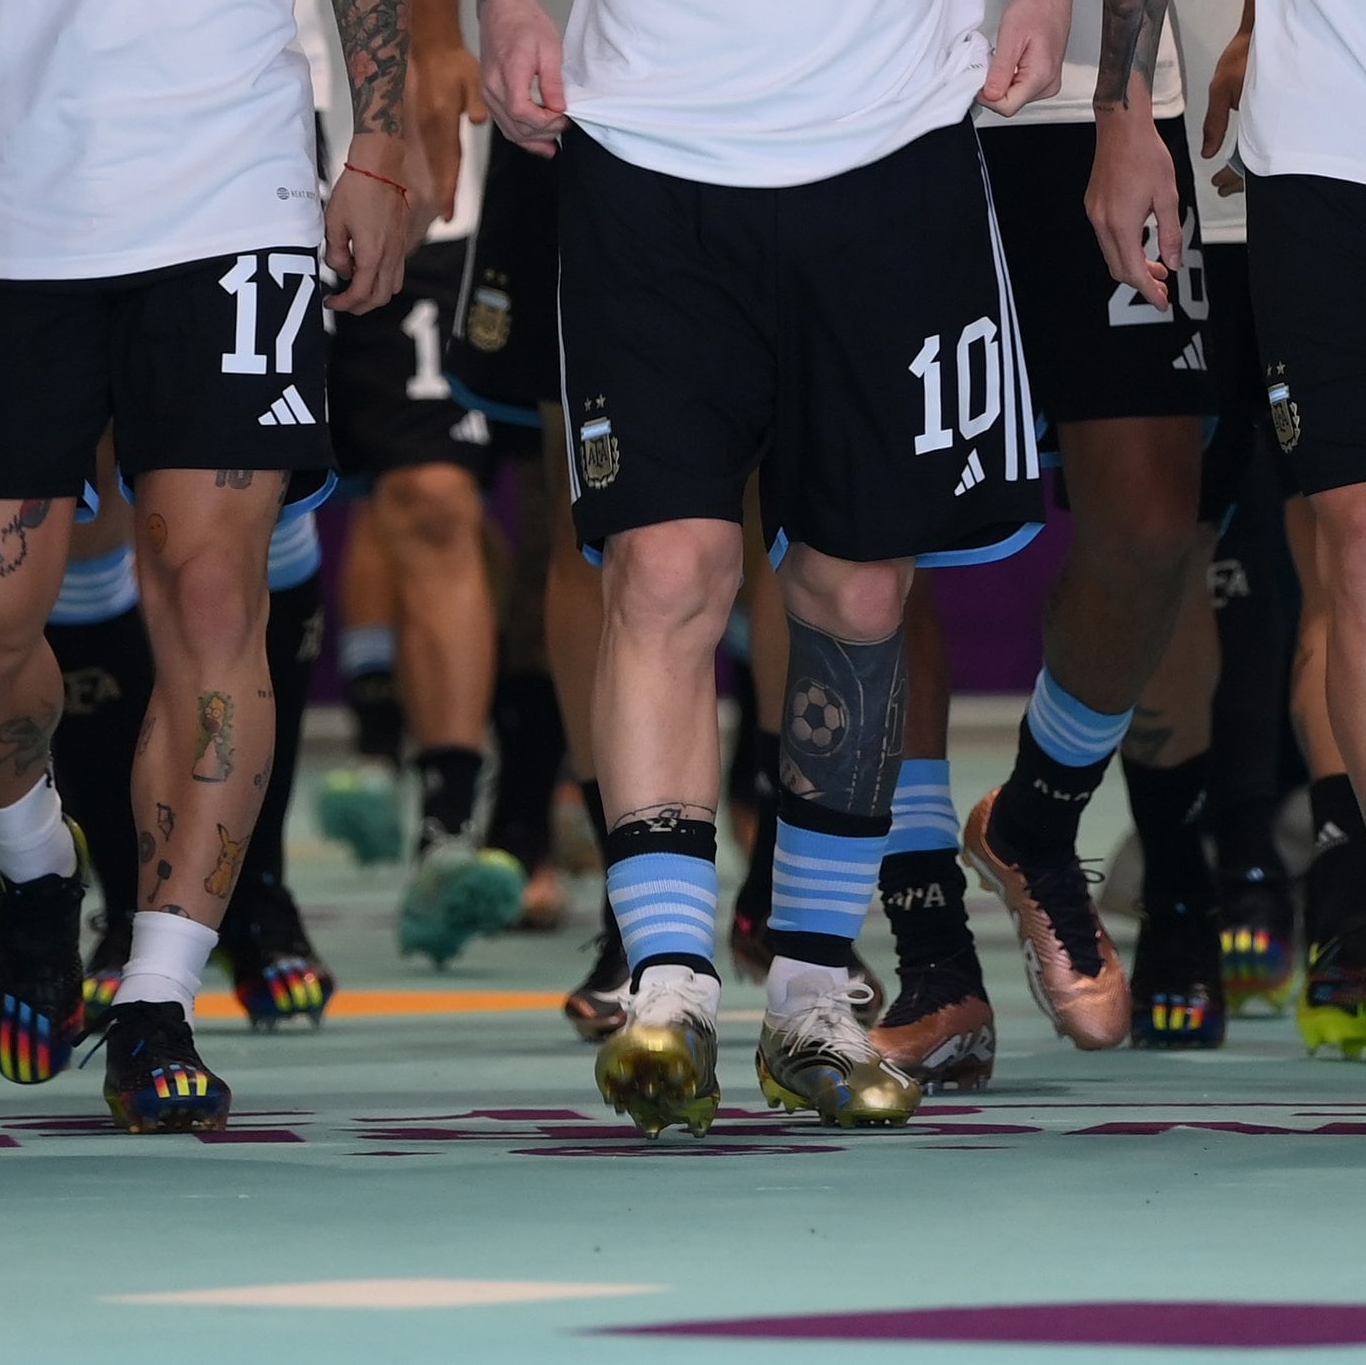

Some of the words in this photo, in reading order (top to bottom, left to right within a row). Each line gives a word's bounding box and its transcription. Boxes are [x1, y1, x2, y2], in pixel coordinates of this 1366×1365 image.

[218, 254, 315, 374] 17
[908, 316, 1001, 455] 10
[588, 440, 610, 473] AFA
[1206, 559, 1251, 608] FA
[64, 667, 123, 715] FA
